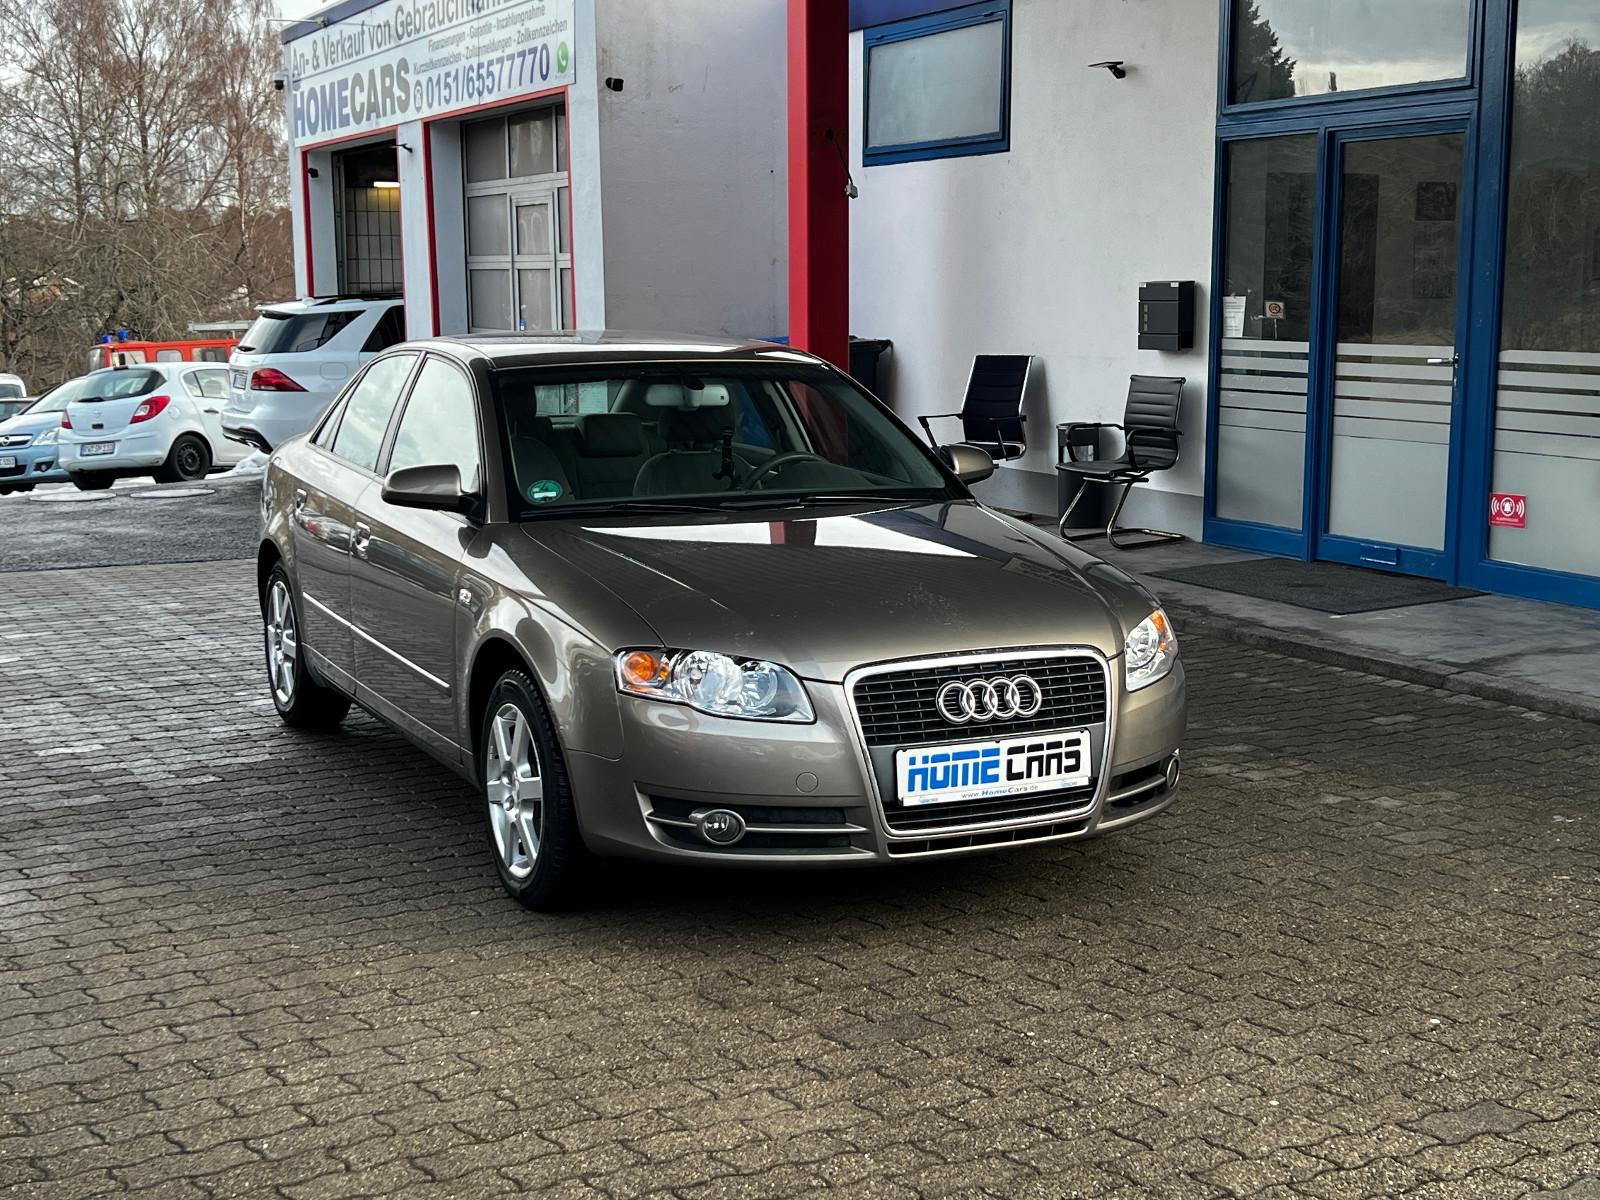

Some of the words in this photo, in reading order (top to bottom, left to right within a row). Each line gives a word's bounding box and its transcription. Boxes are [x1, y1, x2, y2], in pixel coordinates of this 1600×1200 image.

[292, 47, 310, 78] An-
[312, 39, 320, 71] &
[322, 20, 365, 67] Verkauf
[368, 19, 391, 51] von
[426, 43, 550, 109] 0151/65577770
[292, 57, 411, 138] HOMECARS
[907, 747, 1000, 793] HOME
[1006, 738, 1082, 782] CARS
[961, 785, 1039, 799] www.HomeCars.de
